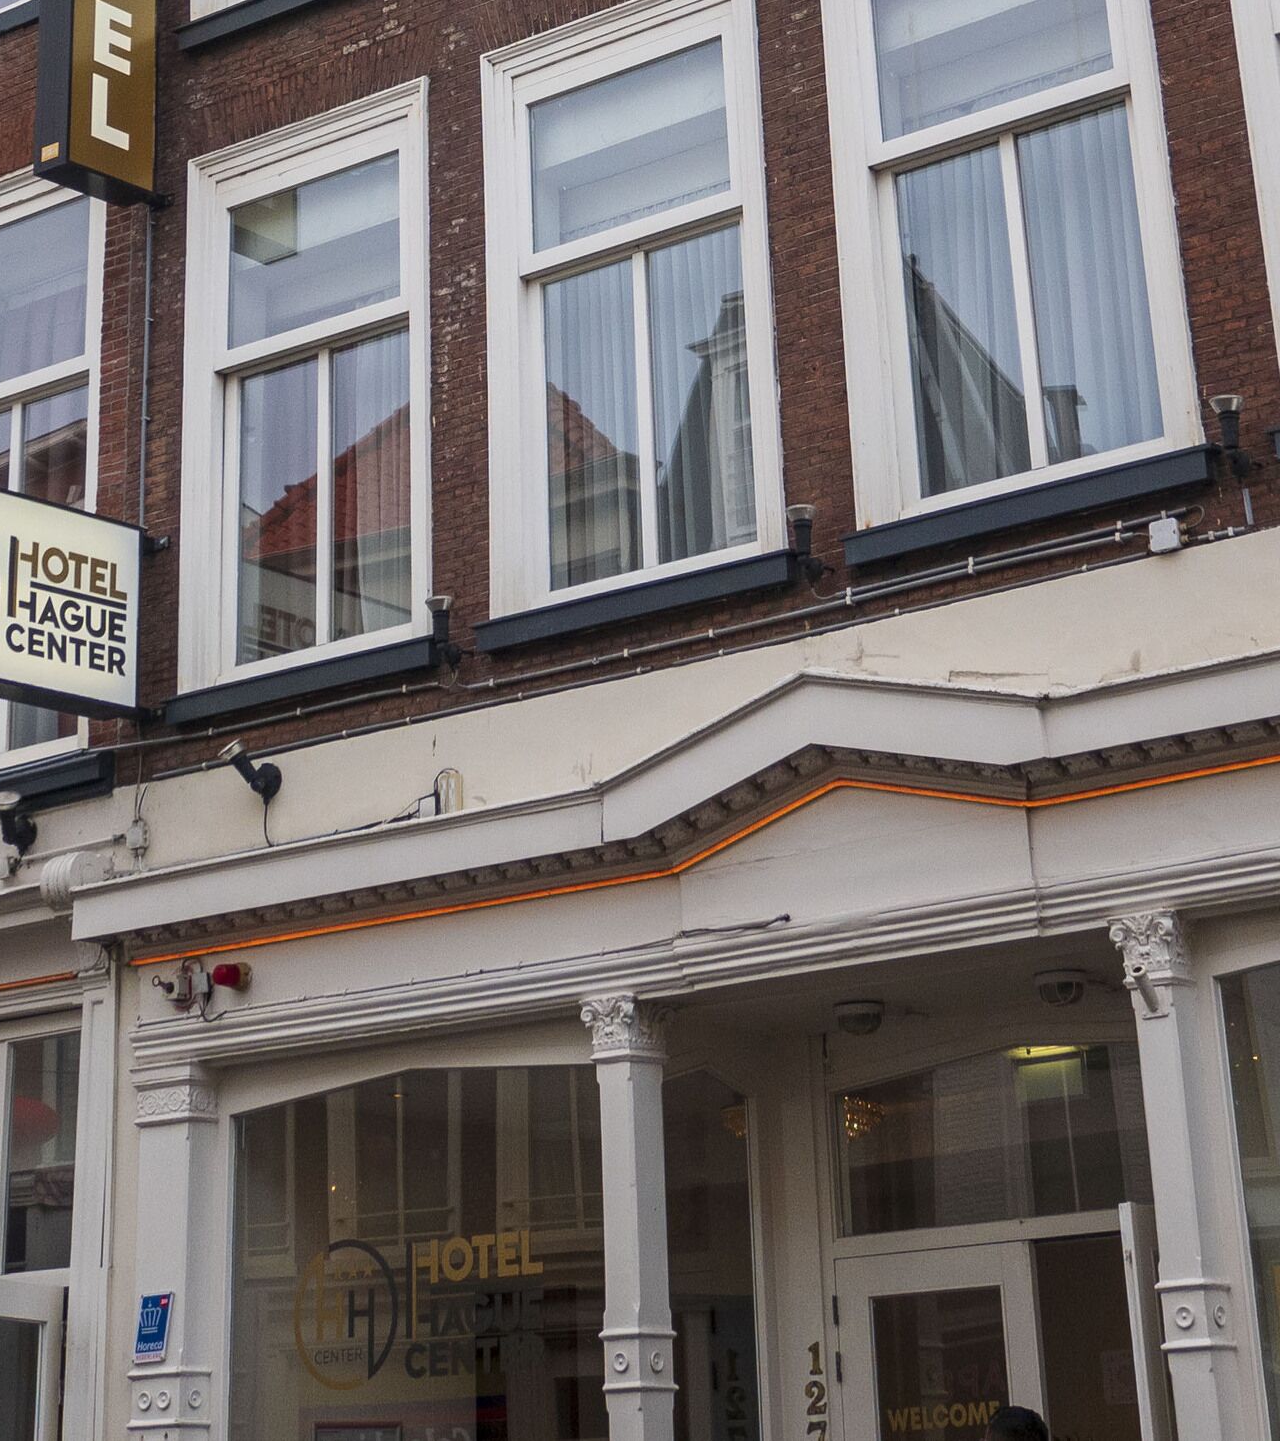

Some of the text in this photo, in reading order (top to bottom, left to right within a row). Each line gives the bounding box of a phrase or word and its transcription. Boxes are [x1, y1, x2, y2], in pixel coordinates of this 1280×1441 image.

[10, 535, 128, 601] HOTEL
[7, 590, 127, 644] HAGUE
[5, 623, 126, 677] CENTER
[406, 1229, 544, 1286] HOTEL
[137, 1341, 163, 1352] Horeca
[314, 1347, 364, 1366] CENTER
[405, 1332, 543, 1379] CENT
